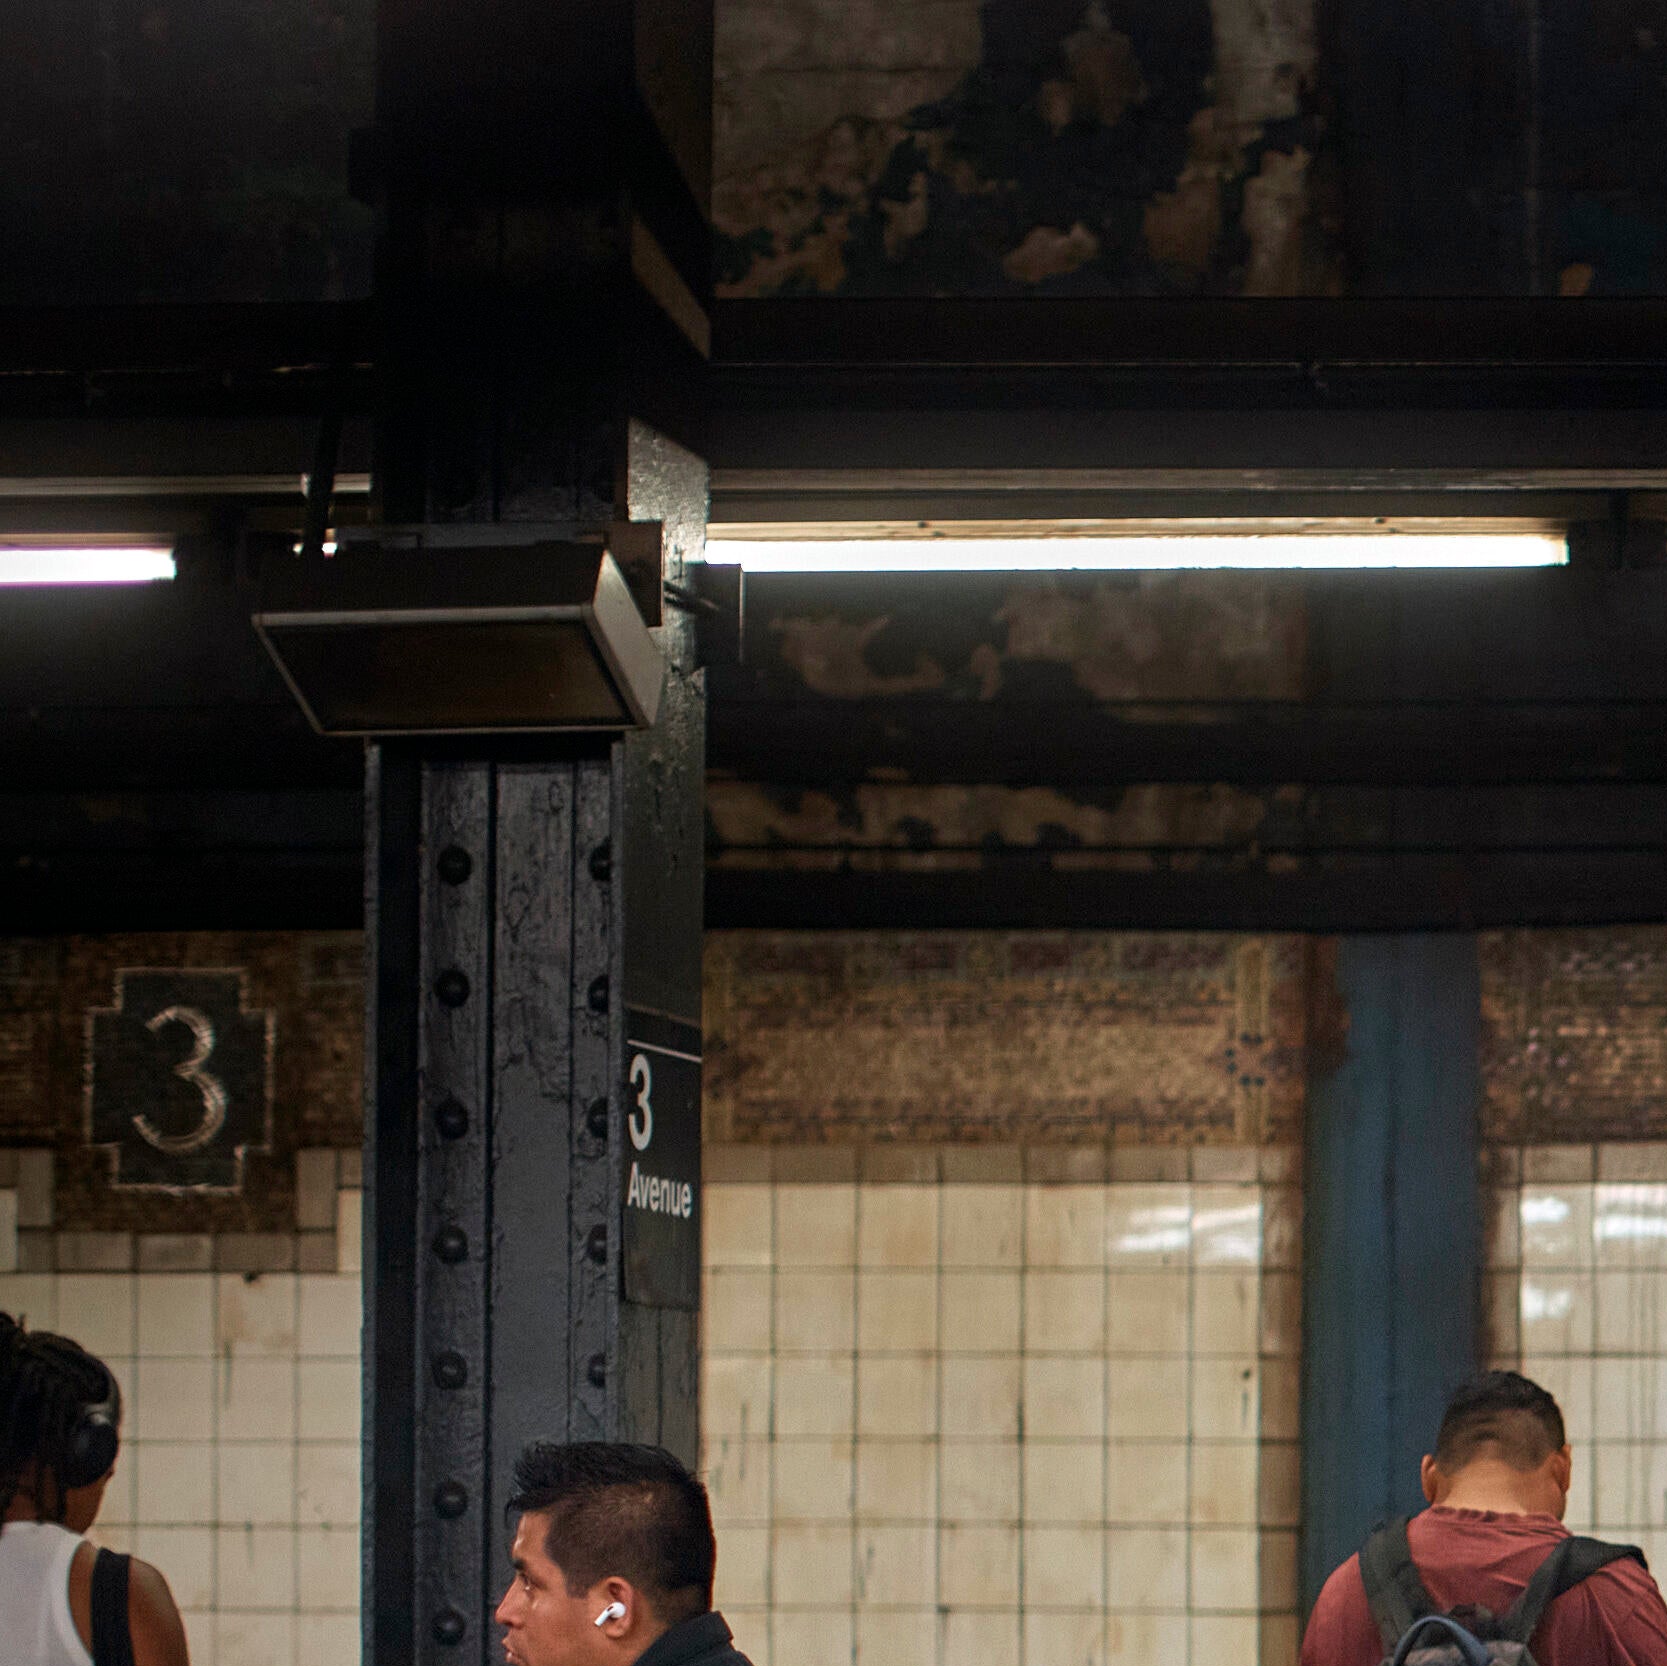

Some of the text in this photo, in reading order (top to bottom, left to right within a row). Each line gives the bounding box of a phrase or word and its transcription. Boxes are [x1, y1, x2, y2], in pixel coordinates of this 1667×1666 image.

[132, 1005, 227, 1154] 3
[628, 1053, 653, 1151] 3
[627, 1161, 693, 1219] Avenue
